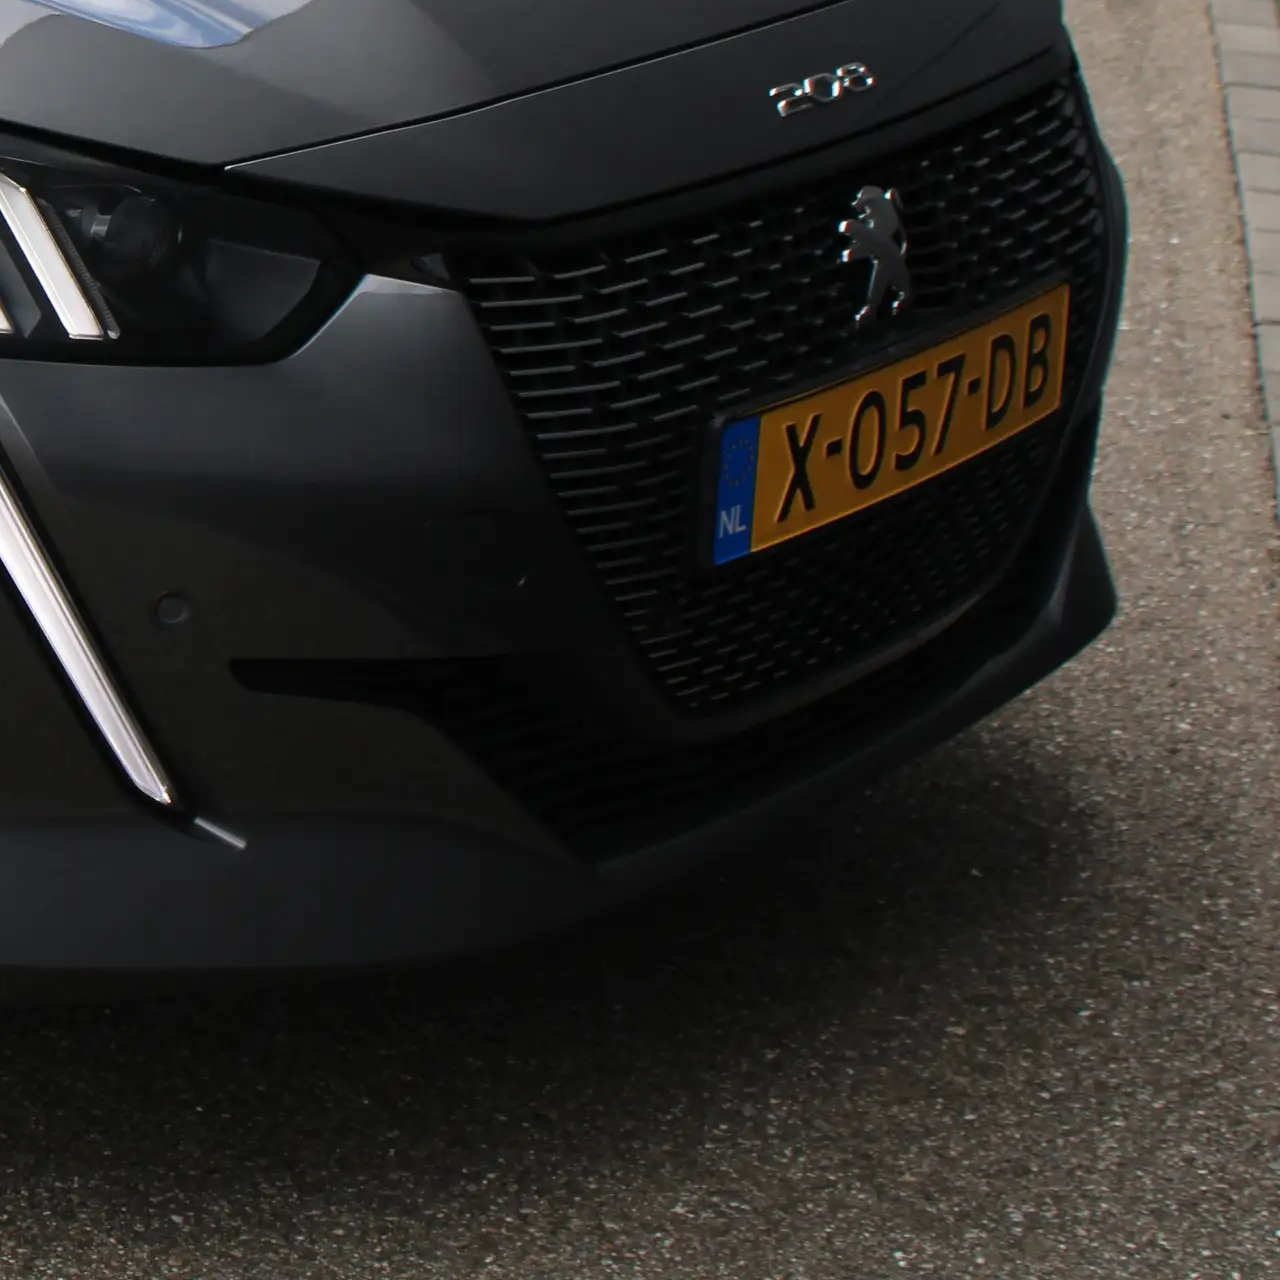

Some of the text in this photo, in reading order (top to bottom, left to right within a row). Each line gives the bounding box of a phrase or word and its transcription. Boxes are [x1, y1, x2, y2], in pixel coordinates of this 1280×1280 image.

[767, 60, 877, 118] 208
[774, 312, 1052, 524] X-057-DB
[718, 504, 748, 539] NL
